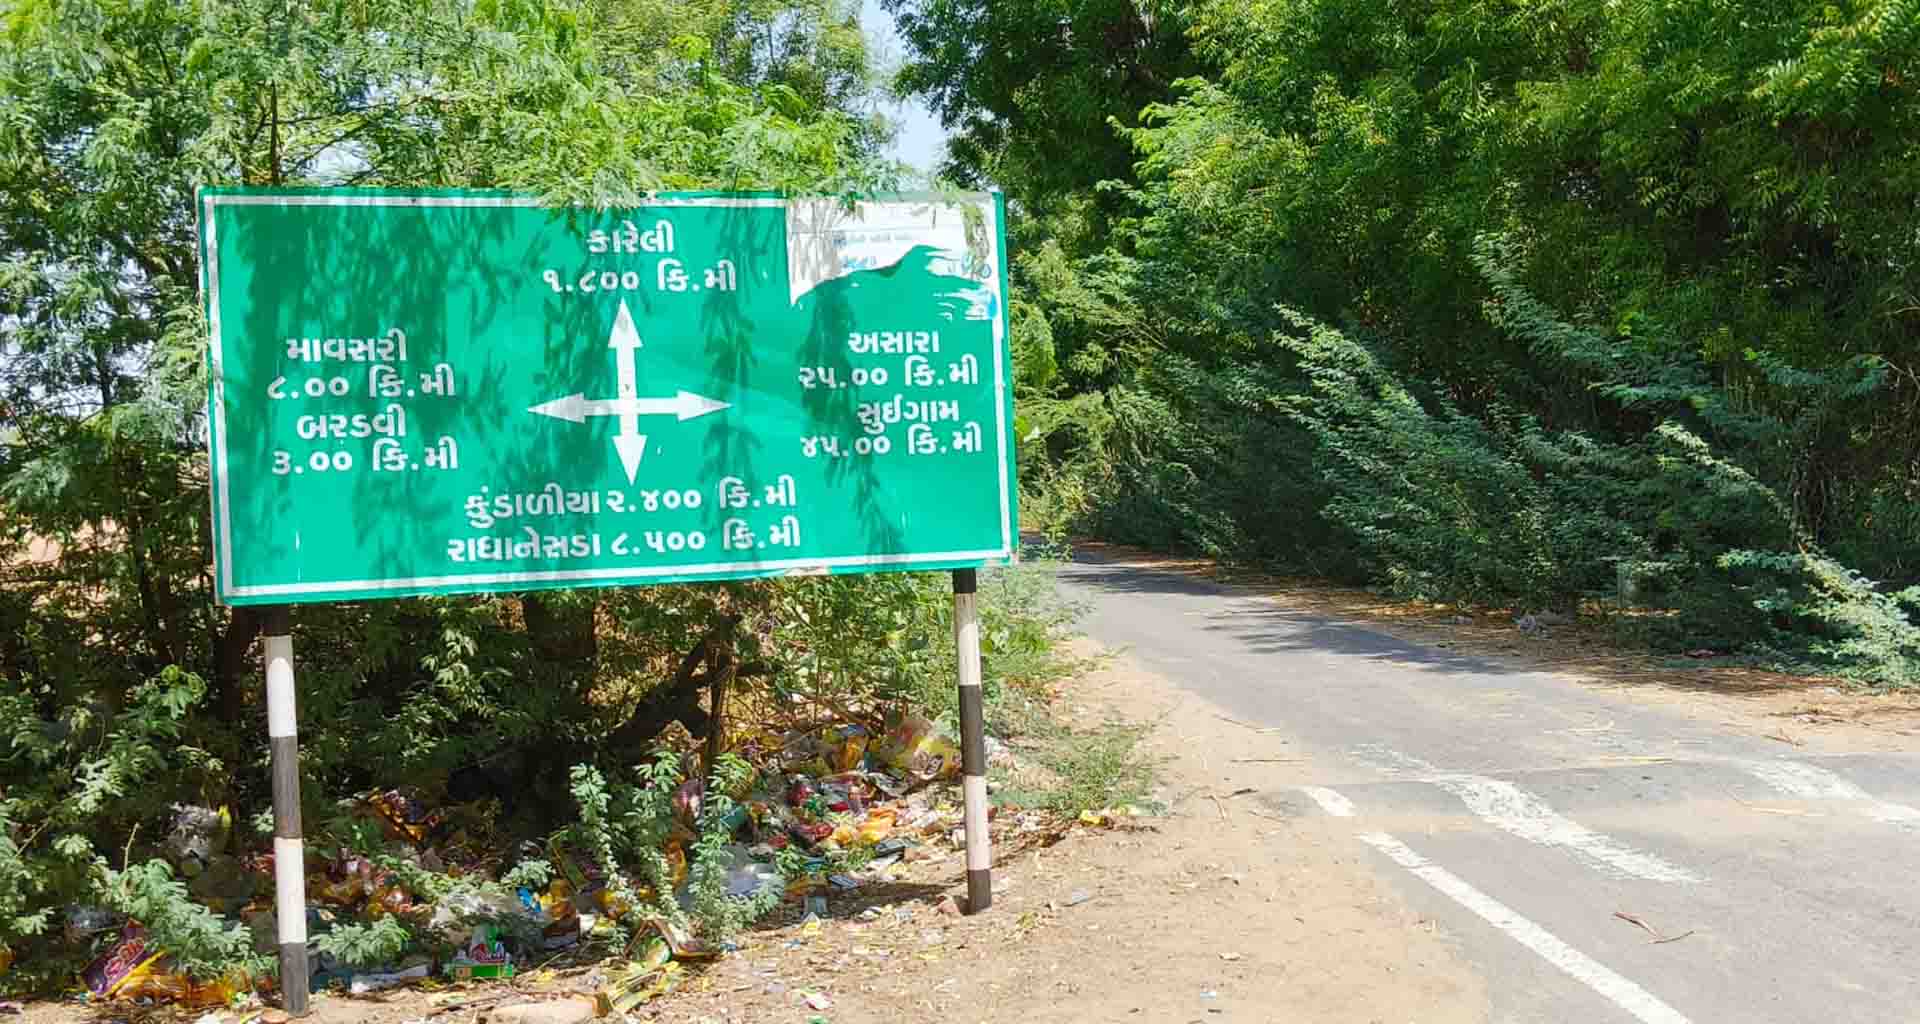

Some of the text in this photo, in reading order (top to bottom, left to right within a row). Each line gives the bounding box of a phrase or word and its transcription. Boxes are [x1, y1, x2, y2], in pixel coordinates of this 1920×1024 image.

[586, 220, 674, 253] કારેલી
[543, 258, 737, 293] ૧.૮૦૦ કિ.મી
[286, 327, 407, 363] માવસરી
[847, 331, 940, 354] અસારા
[267, 363, 455, 400] ૮.૦૦ કિ.મી
[798, 354, 978, 389] ૨૫.૦૦ કિ.મી
[296, 403, 406, 440] બરડવી
[799, 421, 982, 458] ૪૫.૦૦ કિ.મી
[272, 436, 459, 475] ૩.૦૦ કિ.મી
[606, 489, 702, 513] ૨.૪૦૦
[719, 475, 796, 509] કિ.મી
[611, 531, 706, 555] ૮.૫૦૦
[723, 515, 801, 550] કિ.મી
